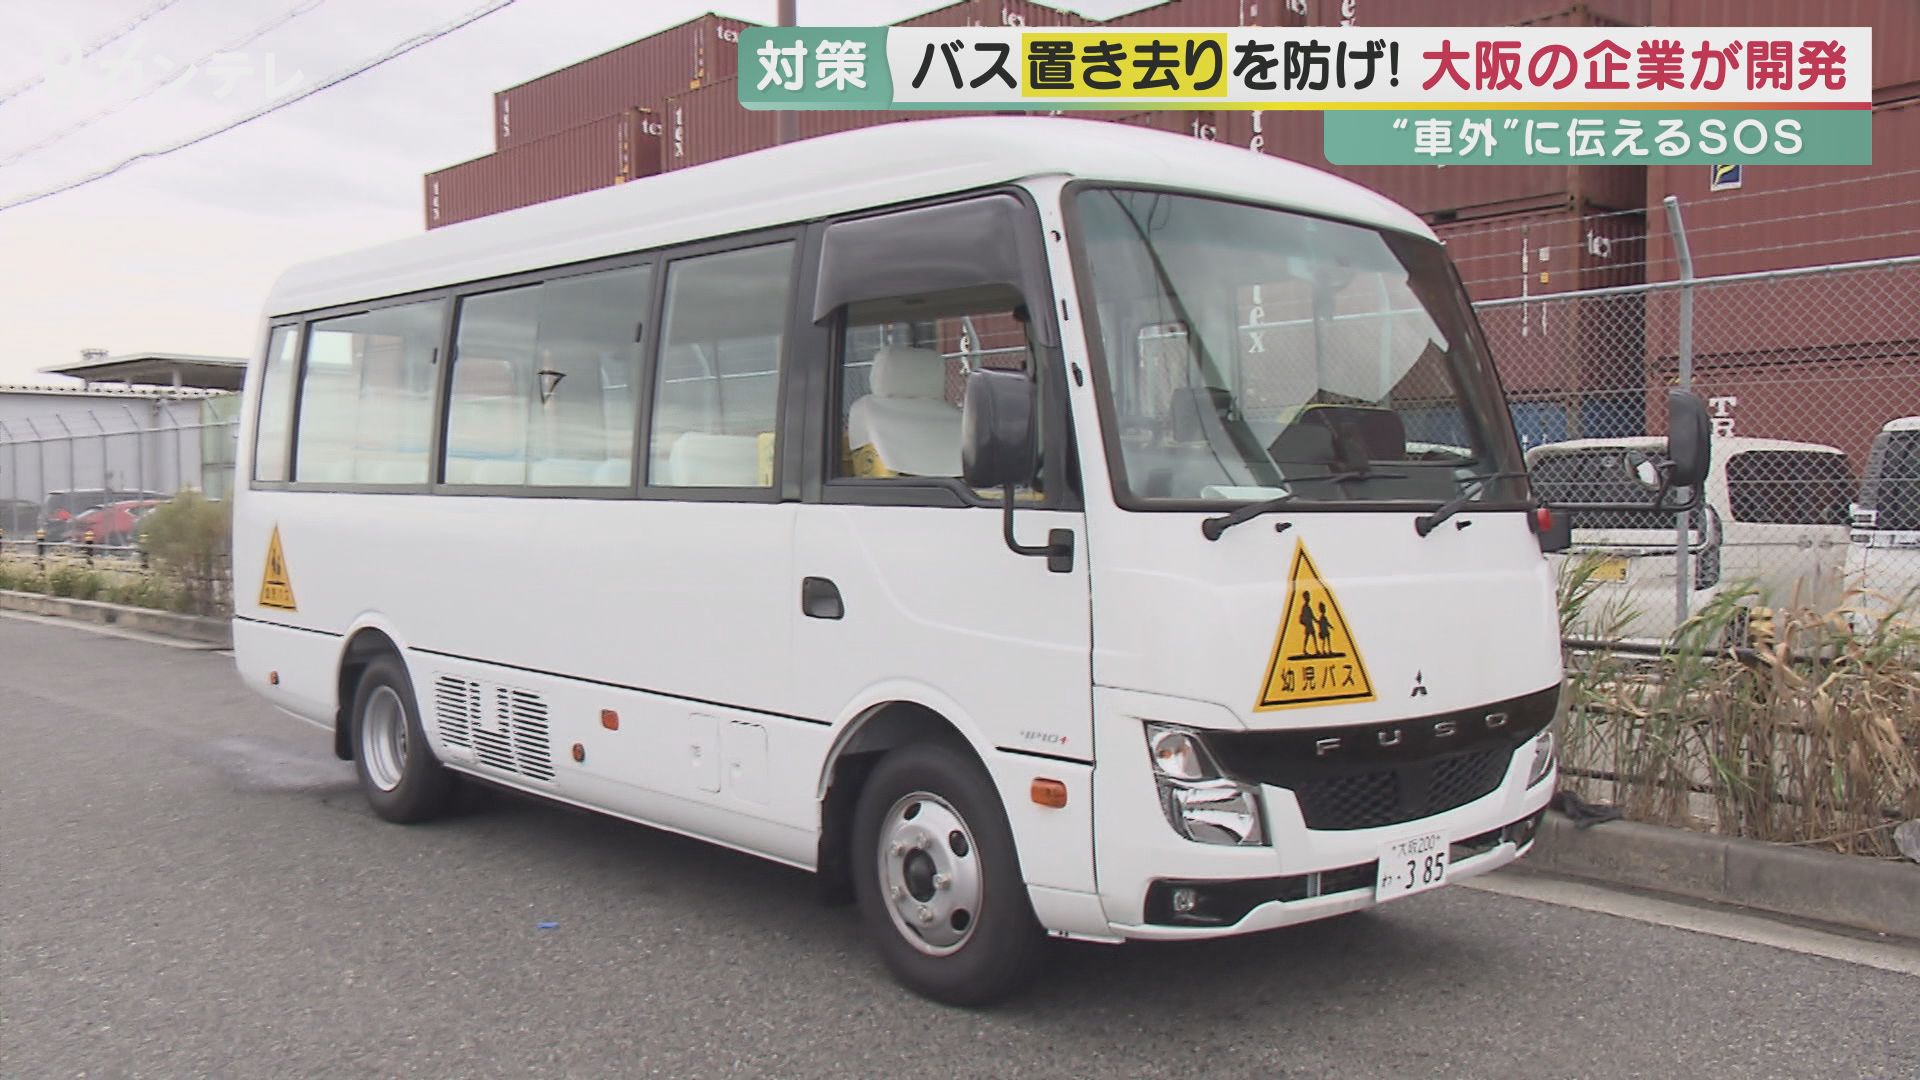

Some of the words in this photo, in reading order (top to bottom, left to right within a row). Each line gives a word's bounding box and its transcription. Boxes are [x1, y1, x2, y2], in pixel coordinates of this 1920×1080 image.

[1281, 664, 1355, 692] 幼児バス
[1316, 712, 1509, 756] FUSO
